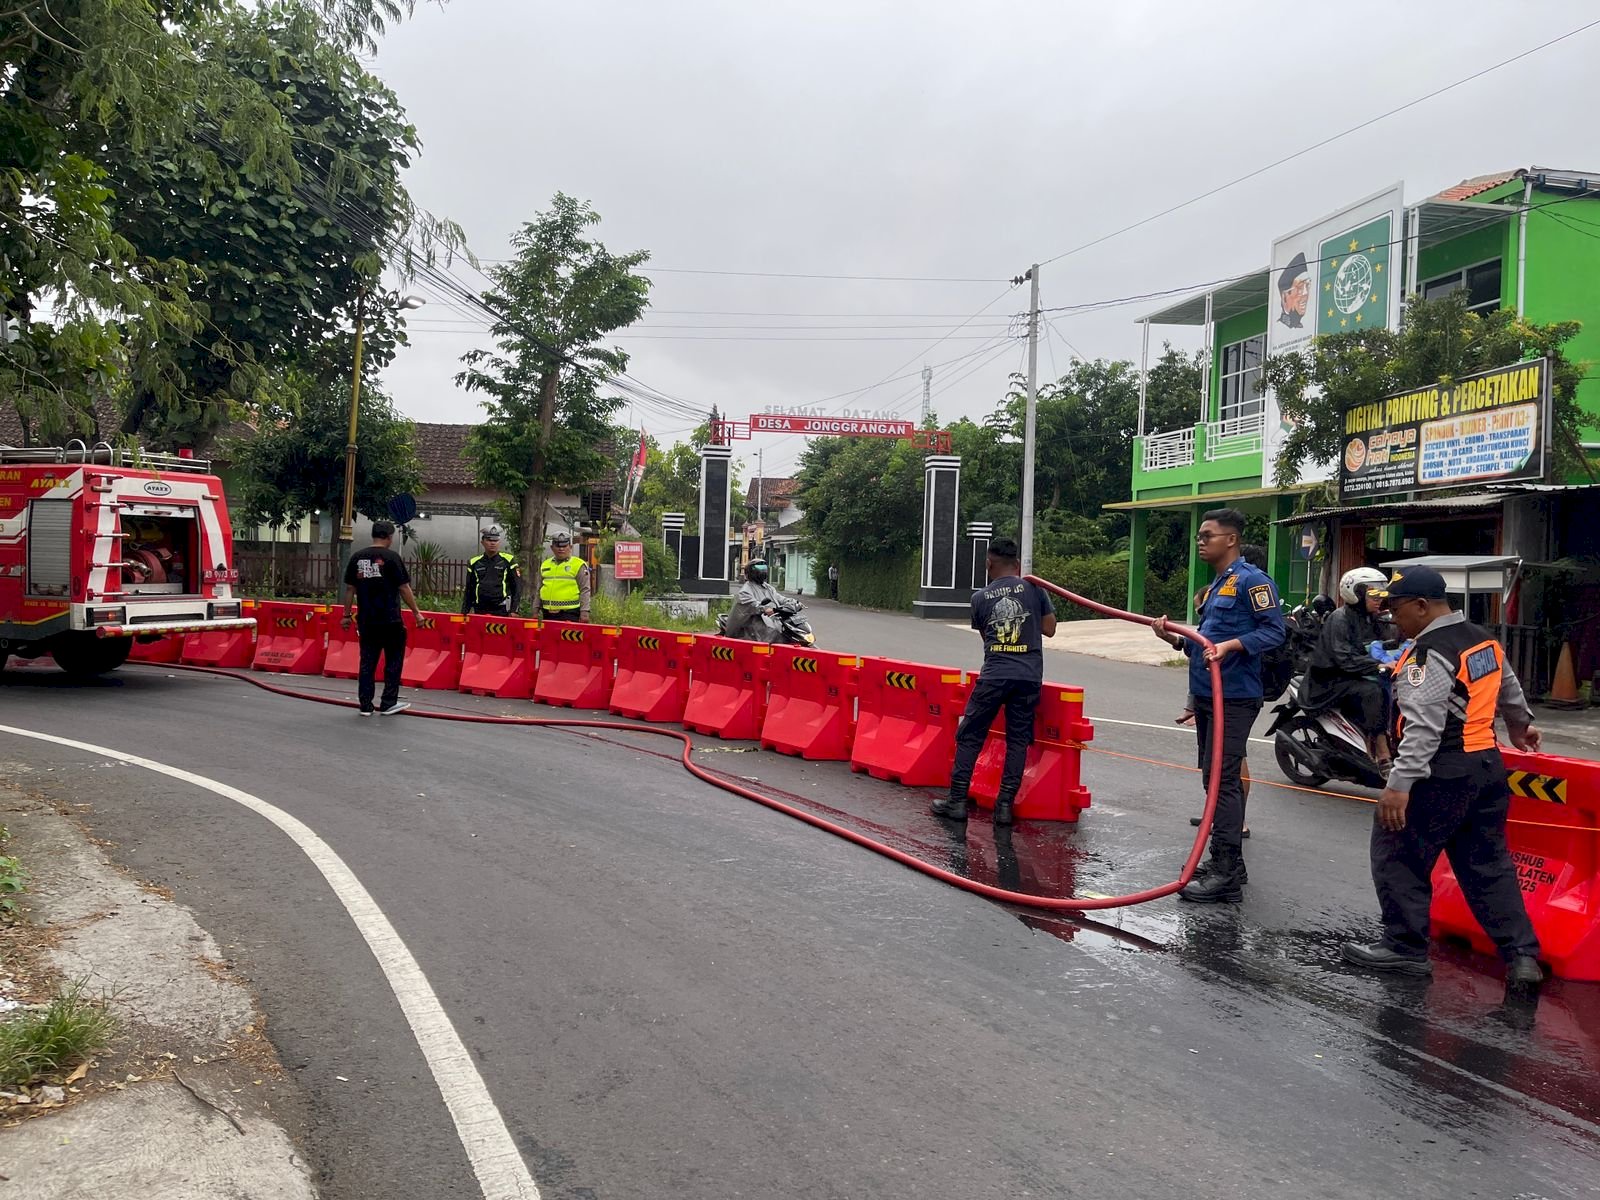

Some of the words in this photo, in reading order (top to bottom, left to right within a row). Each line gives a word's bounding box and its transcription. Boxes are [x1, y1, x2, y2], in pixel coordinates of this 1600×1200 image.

[1345, 401, 1383, 434] DIGITAL
[1386, 389, 1438, 426] PRINTING
[1441, 391, 1450, 416] &
[1453, 366, 1539, 414] PERCETAKAN
[764, 405, 826, 417] SELAMAT
[843, 408, 900, 420] DATANG
[758, 418, 791, 429] DESA
[804, 420, 906, 435] JONGGRANGAN
[1369, 428, 1416, 449] cahaya
[1446, 438, 1460, 449] VINYL
[1489, 427, 1530, 441] TRANSPARANT
[30, 479, 72, 488] AYAXX
[990, 644, 1003, 652] FIRE
[1003, 644, 1028, 652] FIGHTER
[1509, 851, 1545, 868] ISHUB
